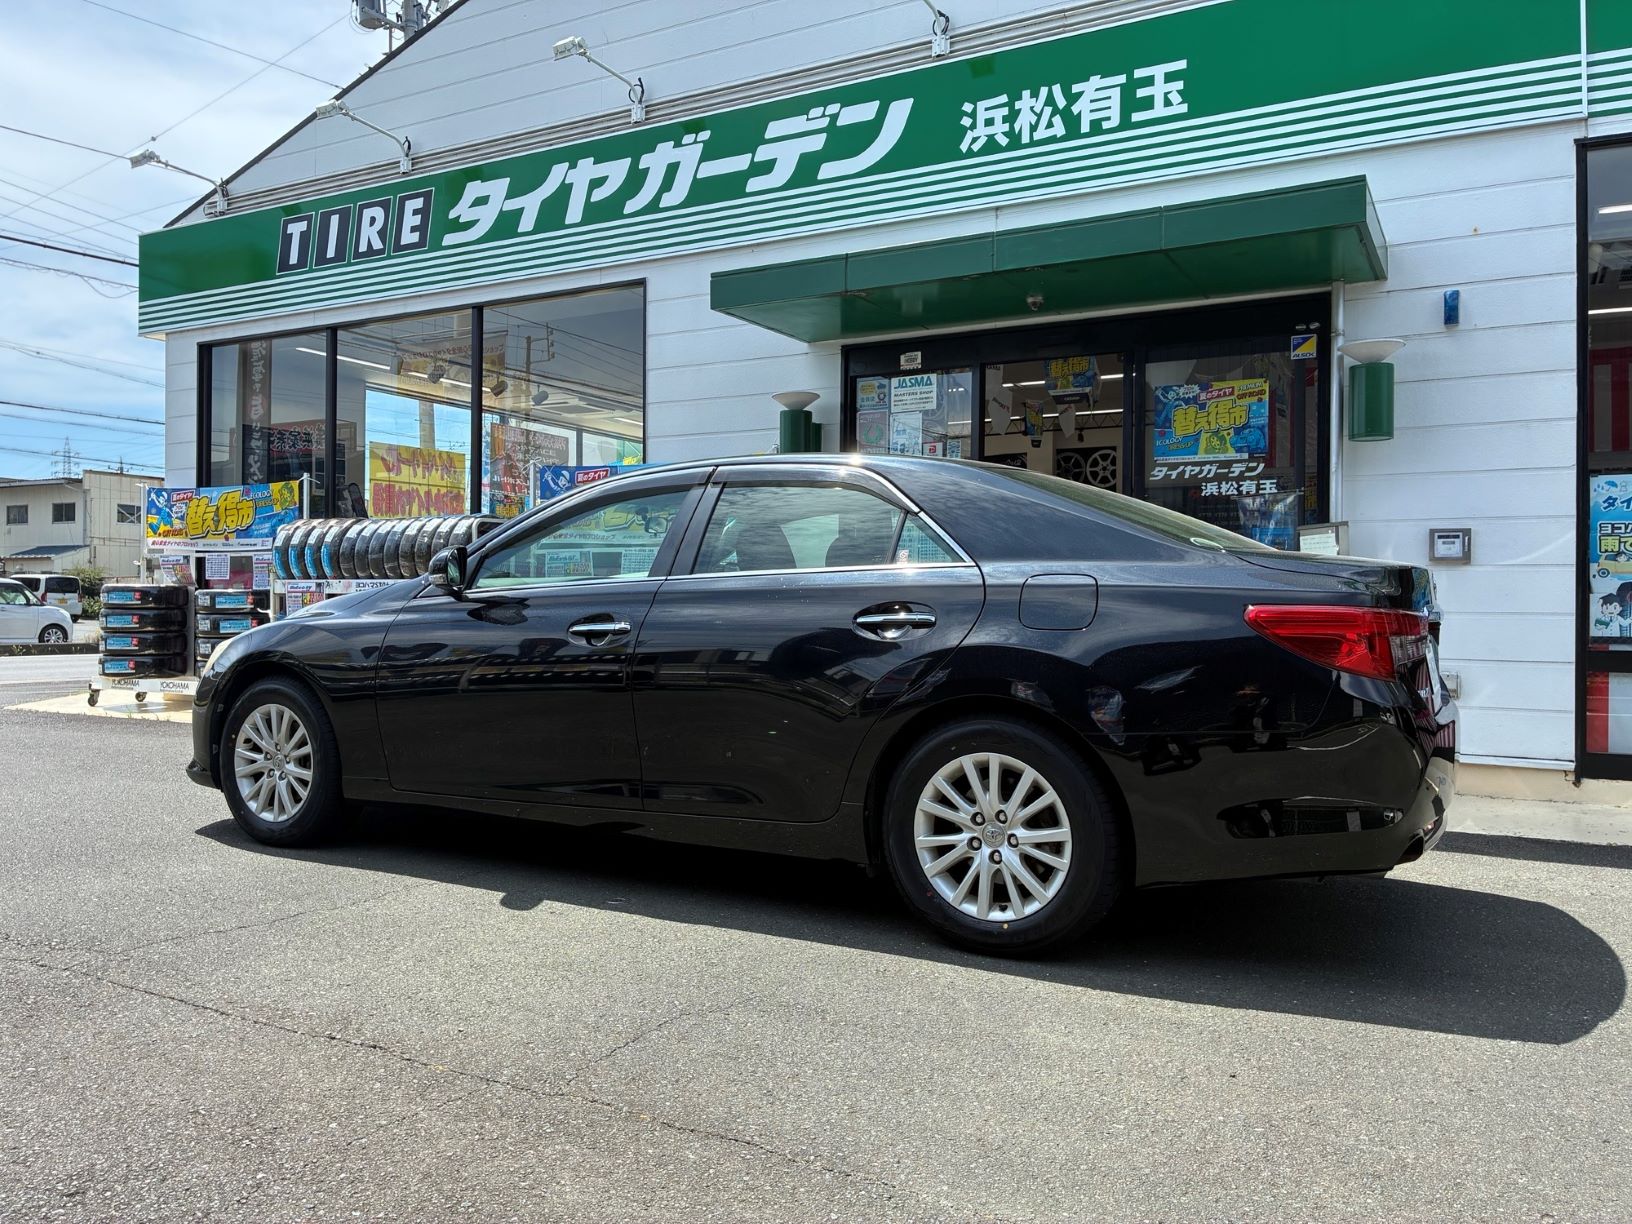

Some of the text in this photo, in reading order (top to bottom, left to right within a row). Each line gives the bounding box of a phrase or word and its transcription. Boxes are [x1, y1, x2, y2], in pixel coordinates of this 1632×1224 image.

[284, 59, 1189, 266] TIRE タイヤガーデン 浜松有玉
[893, 375, 933, 389] JASMA
[1172, 399, 1248, 437] 替え得市
[577, 471, 607, 483] 夏のタイヤ
[1149, 462, 1265, 480] タイヤガーデン
[1200, 479, 1278, 497] 浜松有玉
[187, 490, 256, 534] 替え得市
[111, 679, 140, 687] YOKOHAMA
[160, 681, 190, 689] YOKOHAMA
